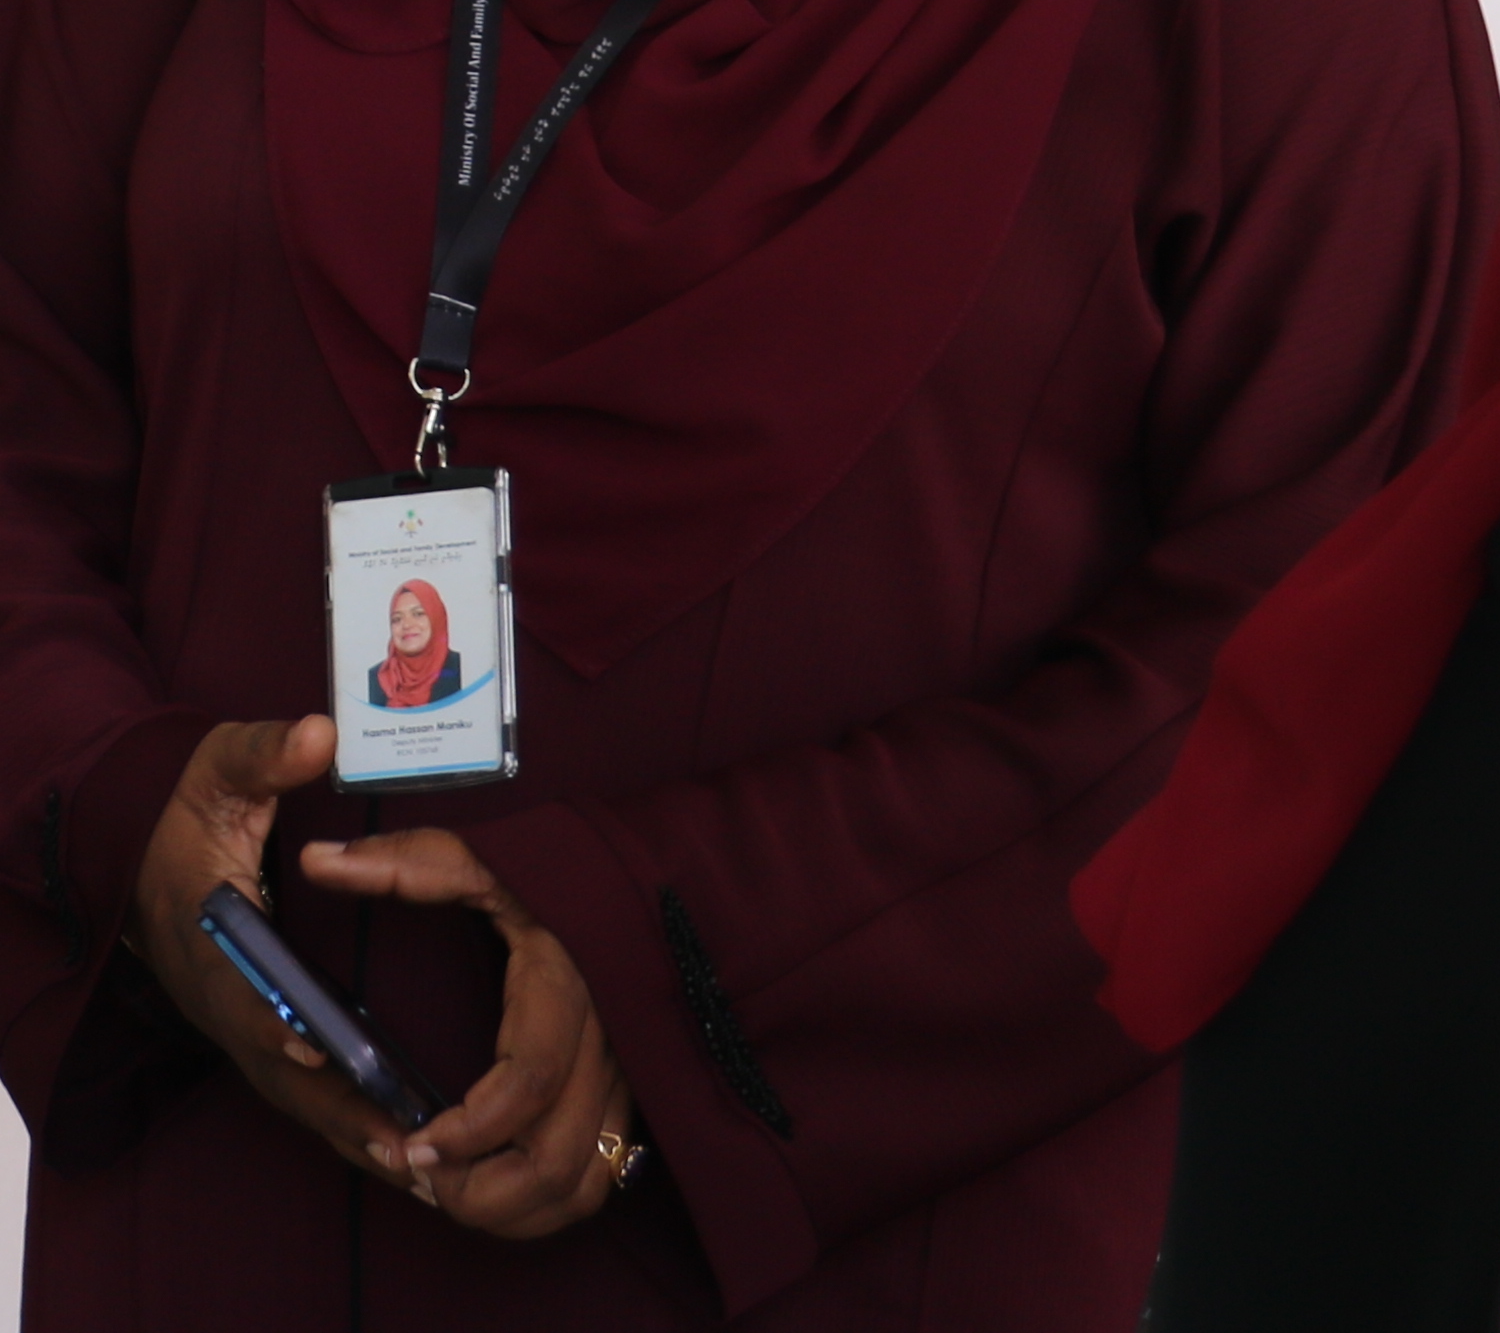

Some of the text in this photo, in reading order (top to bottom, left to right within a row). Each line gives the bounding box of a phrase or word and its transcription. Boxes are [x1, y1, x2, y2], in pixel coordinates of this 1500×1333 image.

[467, 42, 482, 69] And
[465, 71, 480, 110] Social
[463, 111, 476, 128] Of
[457, 130, 477, 187] Ministry
[398, 724, 435, 735] Hassan
[436, 719, 473, 731] Maniku
